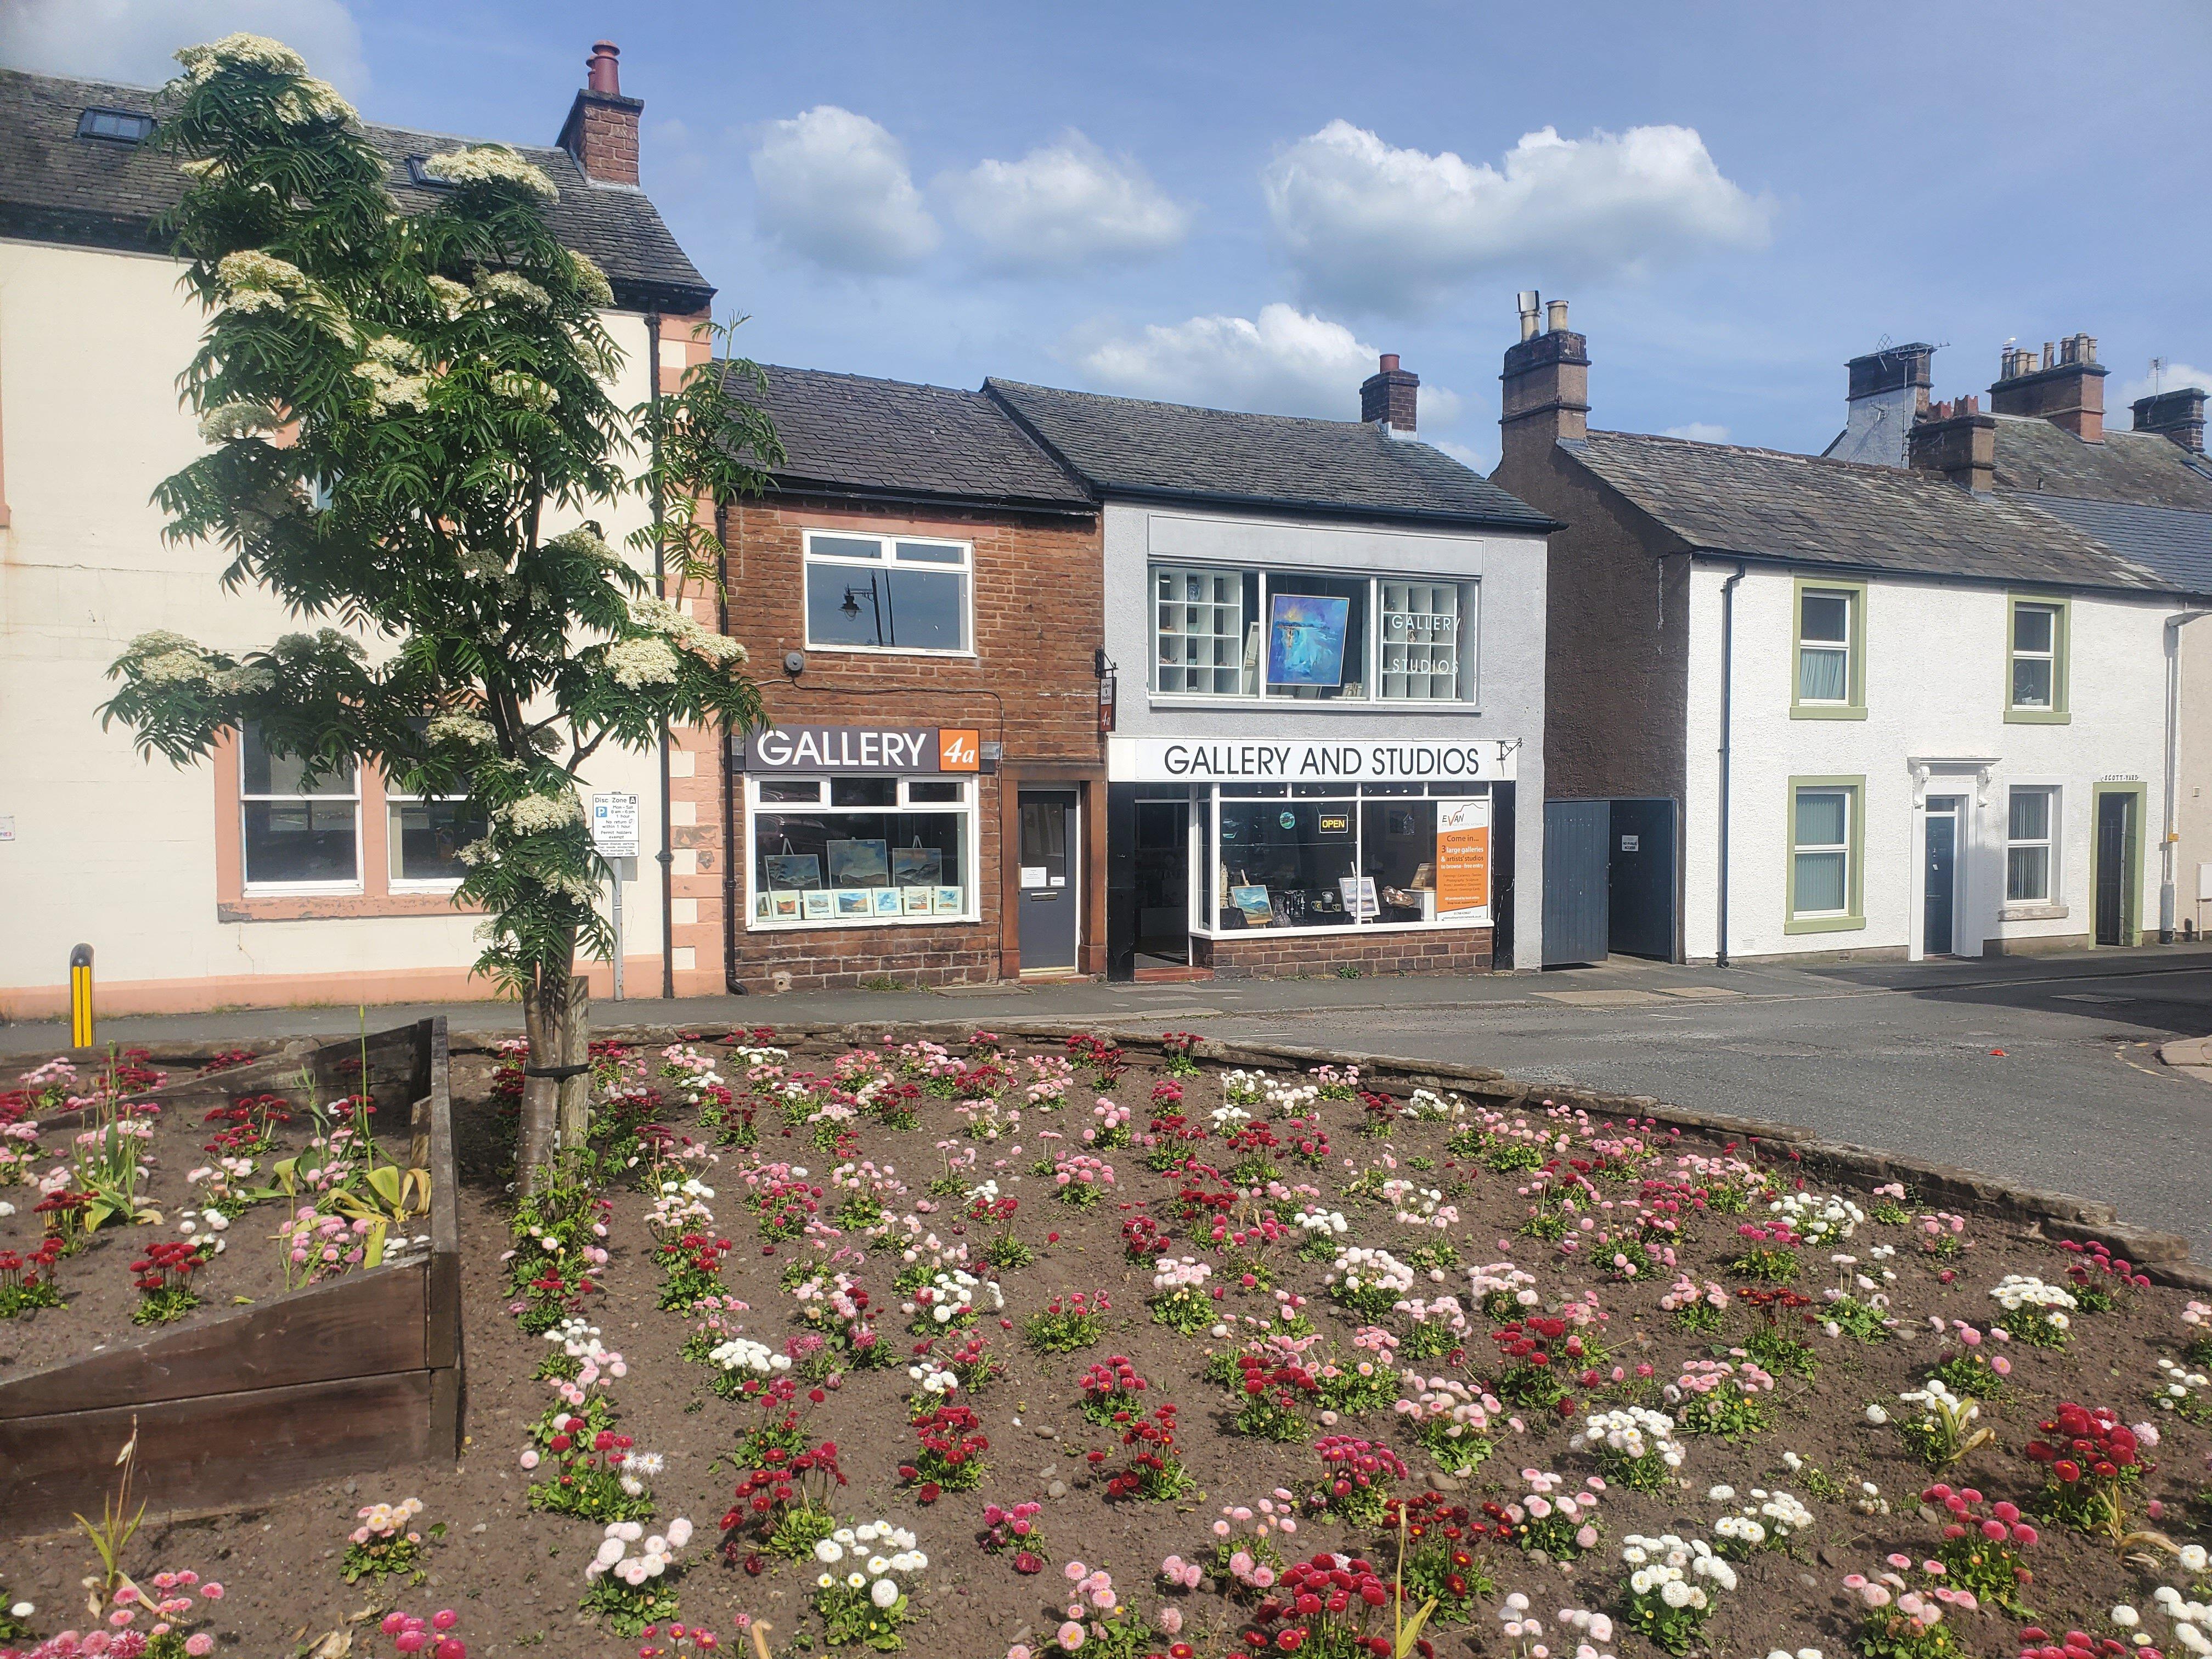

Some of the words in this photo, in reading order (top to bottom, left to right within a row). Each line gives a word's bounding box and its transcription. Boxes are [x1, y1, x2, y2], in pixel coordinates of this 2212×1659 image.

[1392, 615, 1460, 631] GALLERY
[1393, 658, 1459, 673] STUDIOS
[1102, 710, 1111, 726] 4a
[757, 730, 927, 766] GALLERY
[944, 737, 975, 764] 4a
[1164, 745, 1291, 775] GALLERY
[1299, 747, 1362, 775] AND
[1372, 748, 1479, 775] STUDIOS
[598, 808, 605, 817] P
[1442, 813, 1464, 826] EVAN
[1322, 820, 1345, 828] OPEN
[1441, 845, 1446, 853] 3
